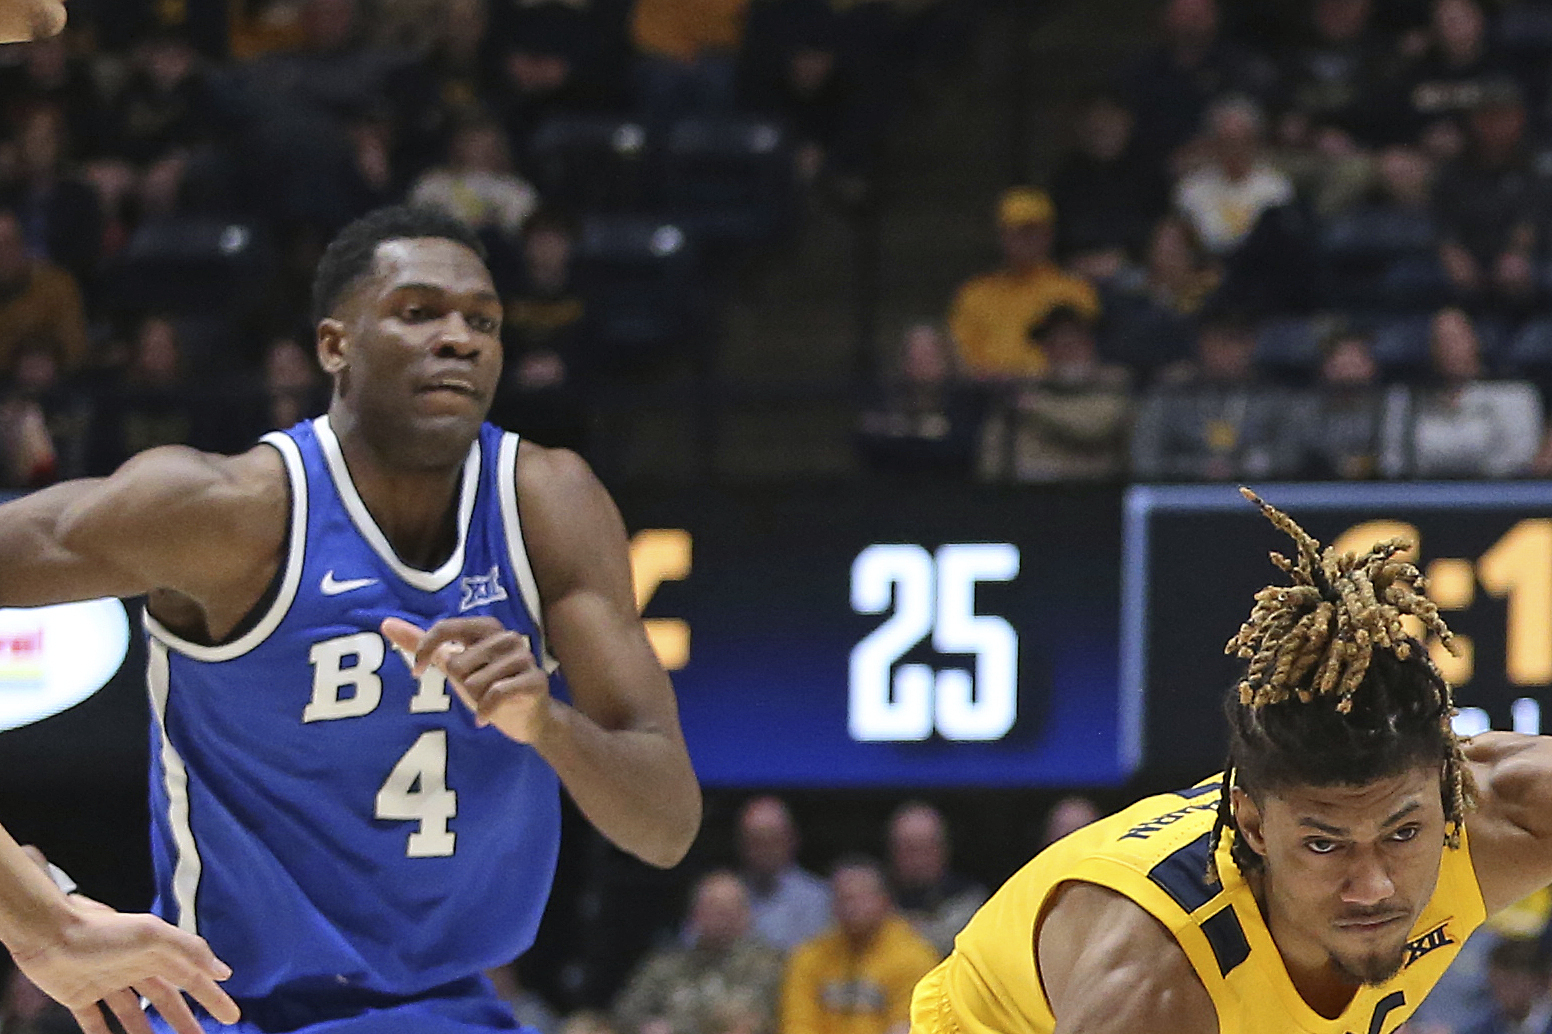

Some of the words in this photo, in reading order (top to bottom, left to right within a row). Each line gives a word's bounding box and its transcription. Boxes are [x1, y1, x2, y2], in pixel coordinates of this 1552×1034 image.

[303, 632, 532, 724] BY
[847, 542, 1020, 742] 25
[375, 731, 457, 858] 4
